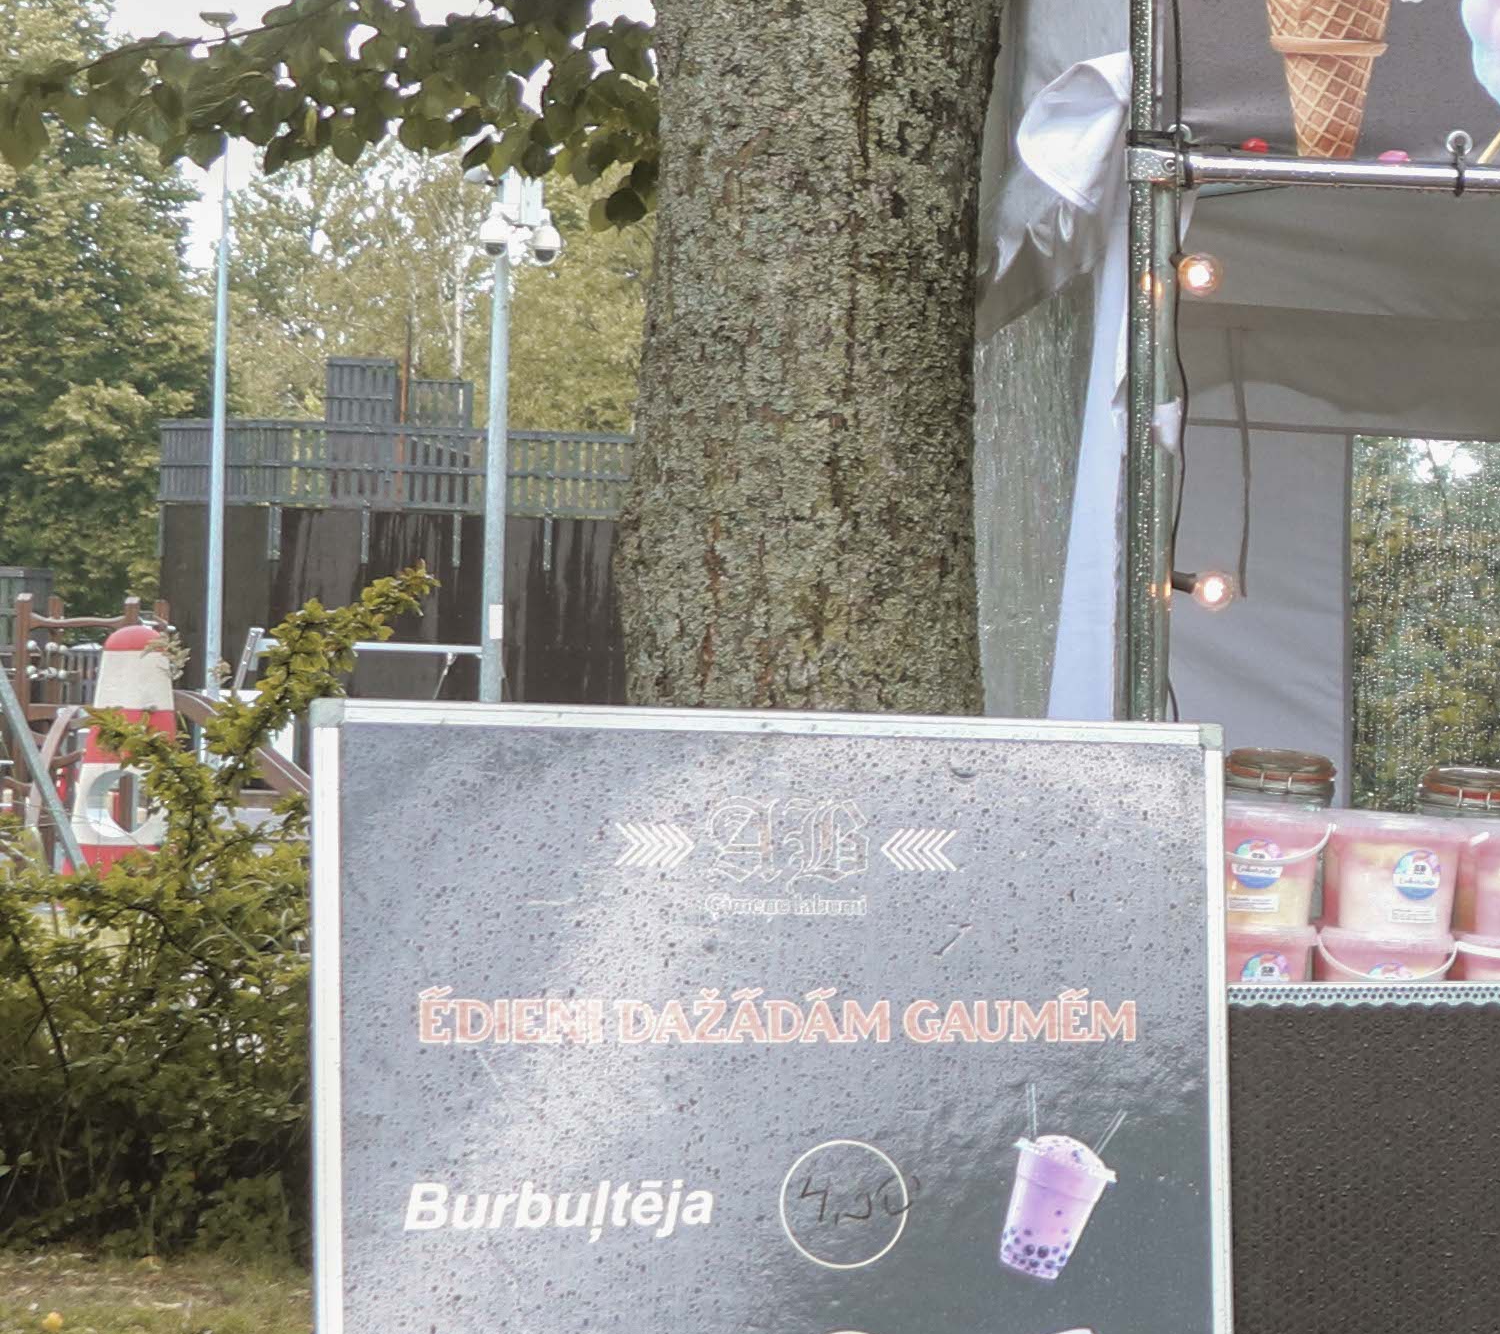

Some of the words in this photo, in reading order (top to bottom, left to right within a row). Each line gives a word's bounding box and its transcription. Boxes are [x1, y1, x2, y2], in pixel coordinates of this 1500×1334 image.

[418, 985, 601, 1045] ĒDIENI
[614, 987, 891, 1044] DAŽĀDĀM
[903, 987, 1137, 1043] GAUMĒM
[403, 1179, 715, 1244] Burbuļtēja
